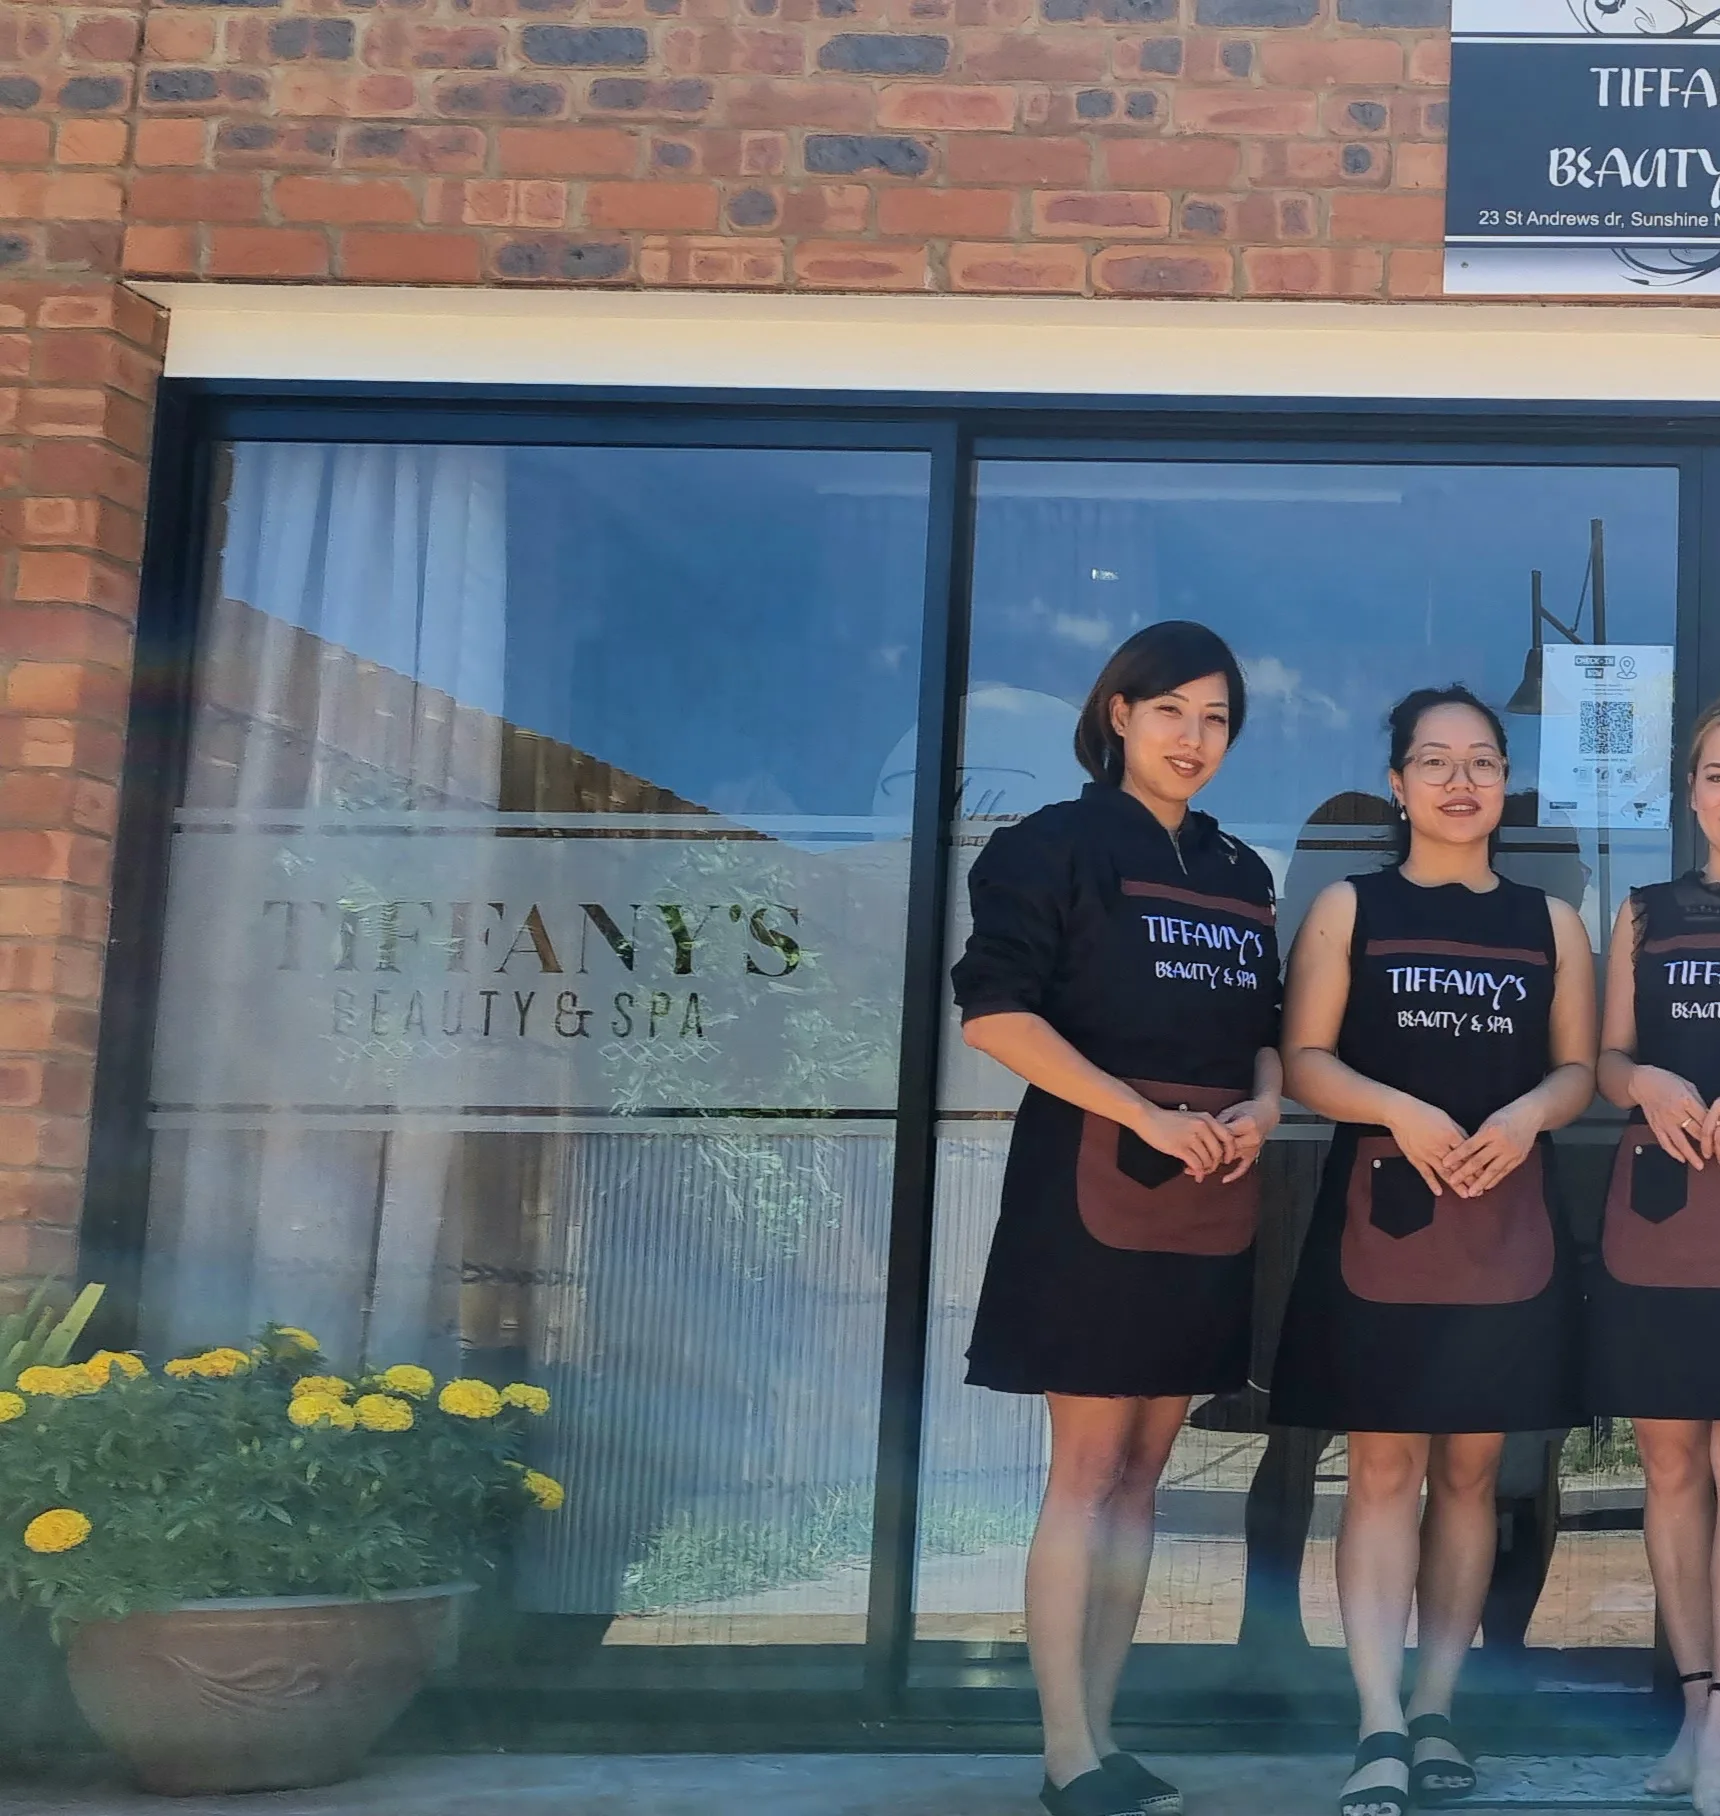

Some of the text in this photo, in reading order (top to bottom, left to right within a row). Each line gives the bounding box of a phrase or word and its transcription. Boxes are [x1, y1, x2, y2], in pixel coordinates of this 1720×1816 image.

[1478, 210, 1500, 226] 23
[1505, 210, 1524, 226] St
[1526, 210, 1600, 226] Andrews
[1604, 211, 1625, 229] dr,
[1630, 211, 1709, 227] Sunshine
[263, 899, 803, 978] TIFFANY'S
[1141, 915, 1263, 965] TIFFANY'S
[1155, 960, 1257, 990] BEAUTY & SPA
[1386, 966, 1527, 1010] TIFFANY'S
[610, 990, 705, 1039] SPA
[1397, 1009, 1514, 1037] BEAUTY & SPA
